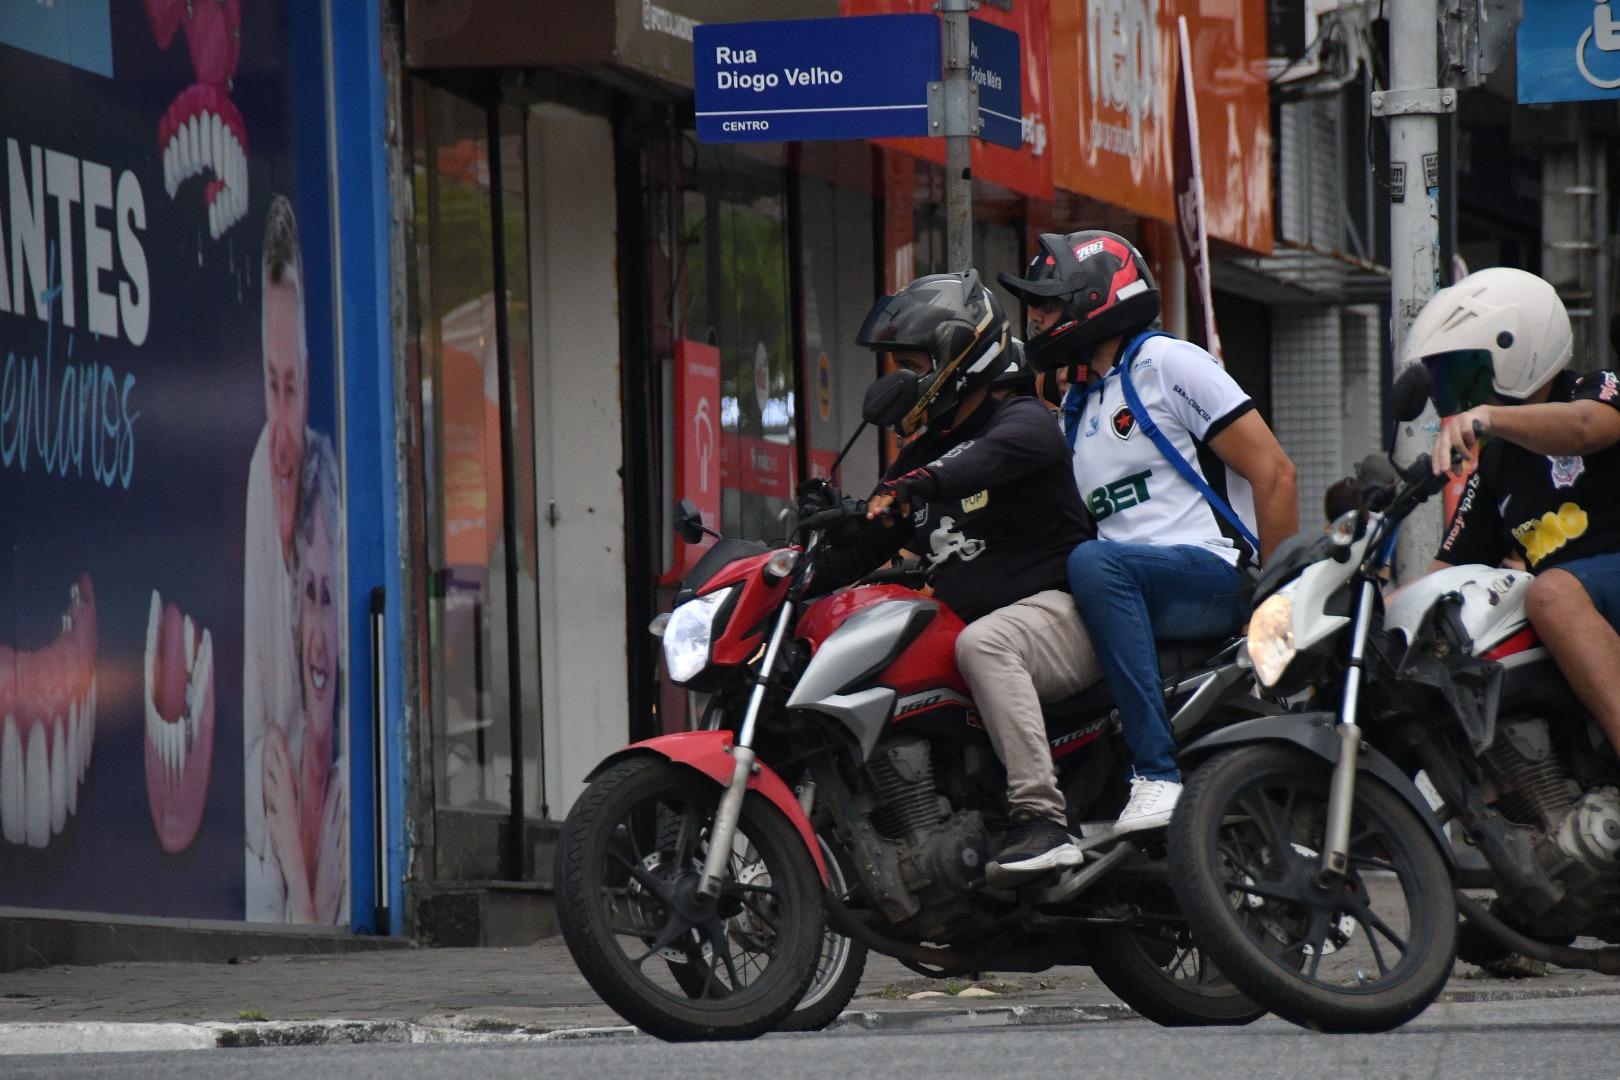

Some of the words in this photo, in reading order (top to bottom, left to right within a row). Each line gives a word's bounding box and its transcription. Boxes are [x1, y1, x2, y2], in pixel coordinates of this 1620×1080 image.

[716, 46, 757, 65] Rua
[717, 71, 779, 92] Diogo
[783, 67, 843, 86] Velho
[971, 65, 987, 86] Padre
[986, 69, 1002, 90] Meira
[722, 120, 769, 132] CENTRO
